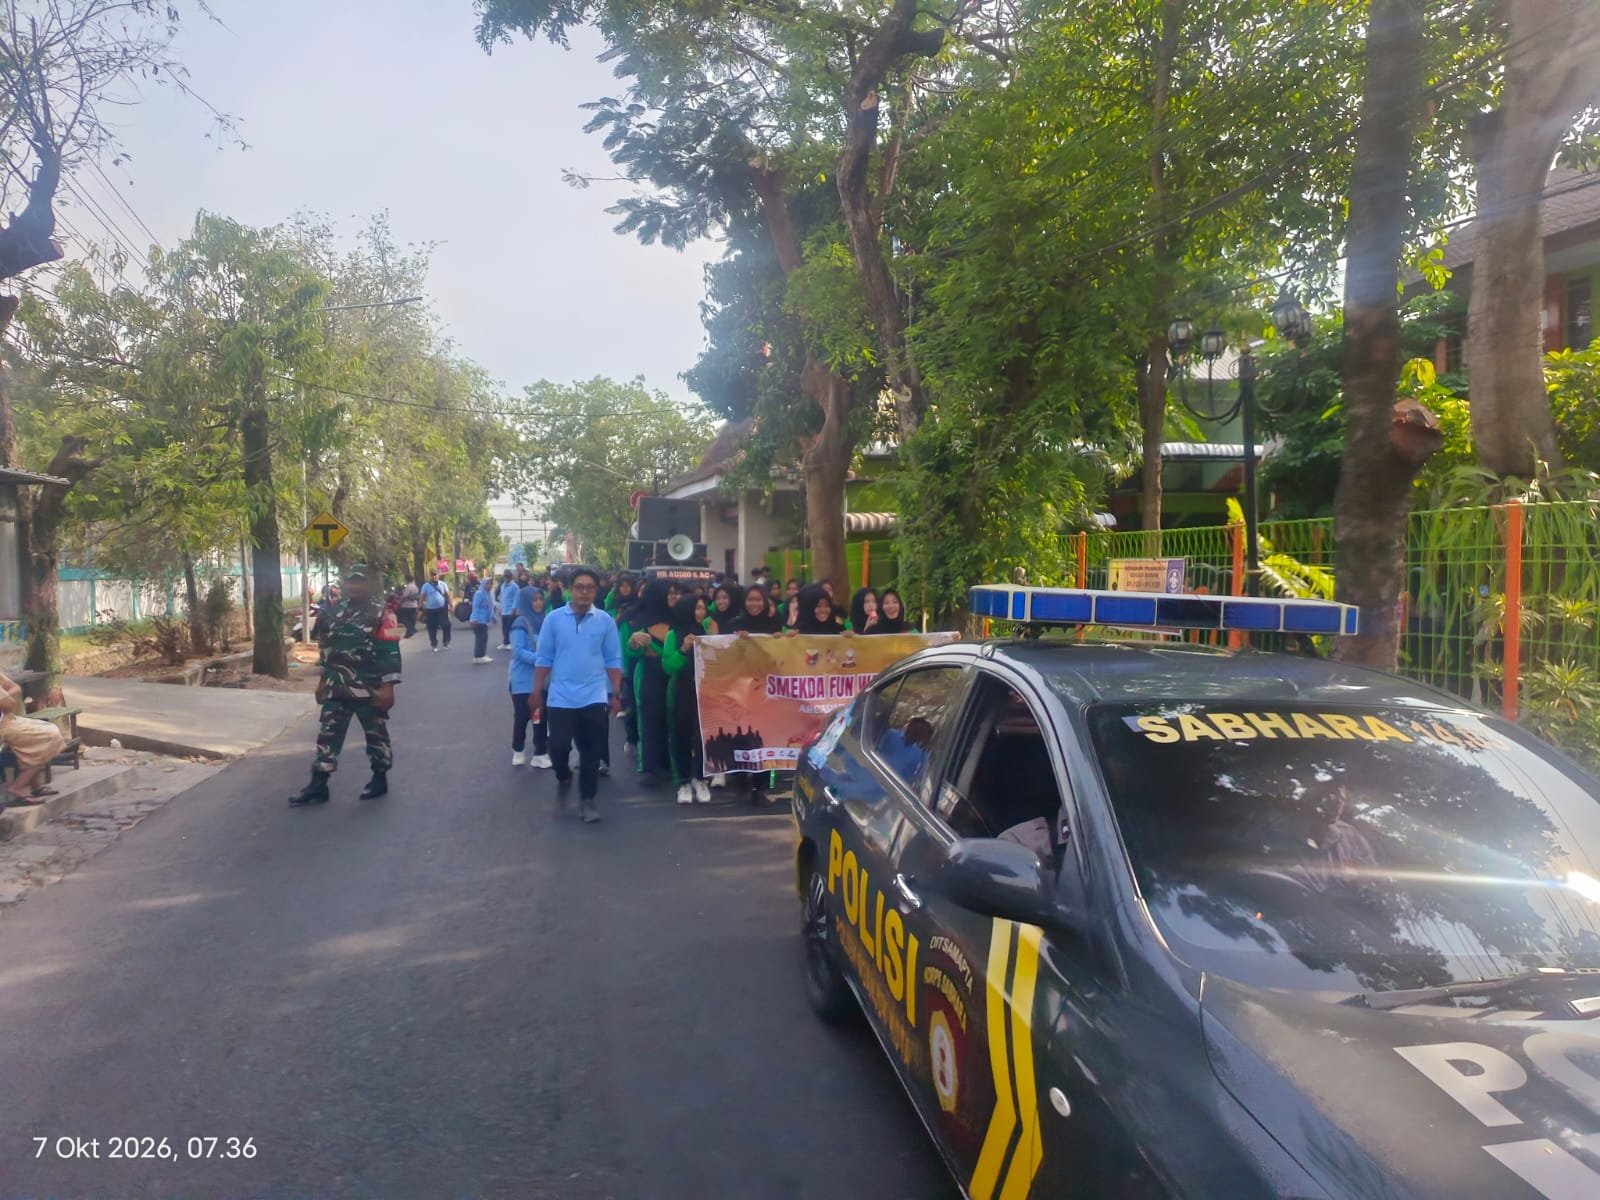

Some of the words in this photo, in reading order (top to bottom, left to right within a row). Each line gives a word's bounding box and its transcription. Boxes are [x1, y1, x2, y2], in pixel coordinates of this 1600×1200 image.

[767, 675, 826, 700] SMEKDA
[829, 675, 854, 698] FUN
[858, 673, 879, 695] W
[1136, 711, 1414, 744] SABHARA
[828, 828, 920, 1027] POLISI
[929, 935, 974, 997] DITSAMAPTA
